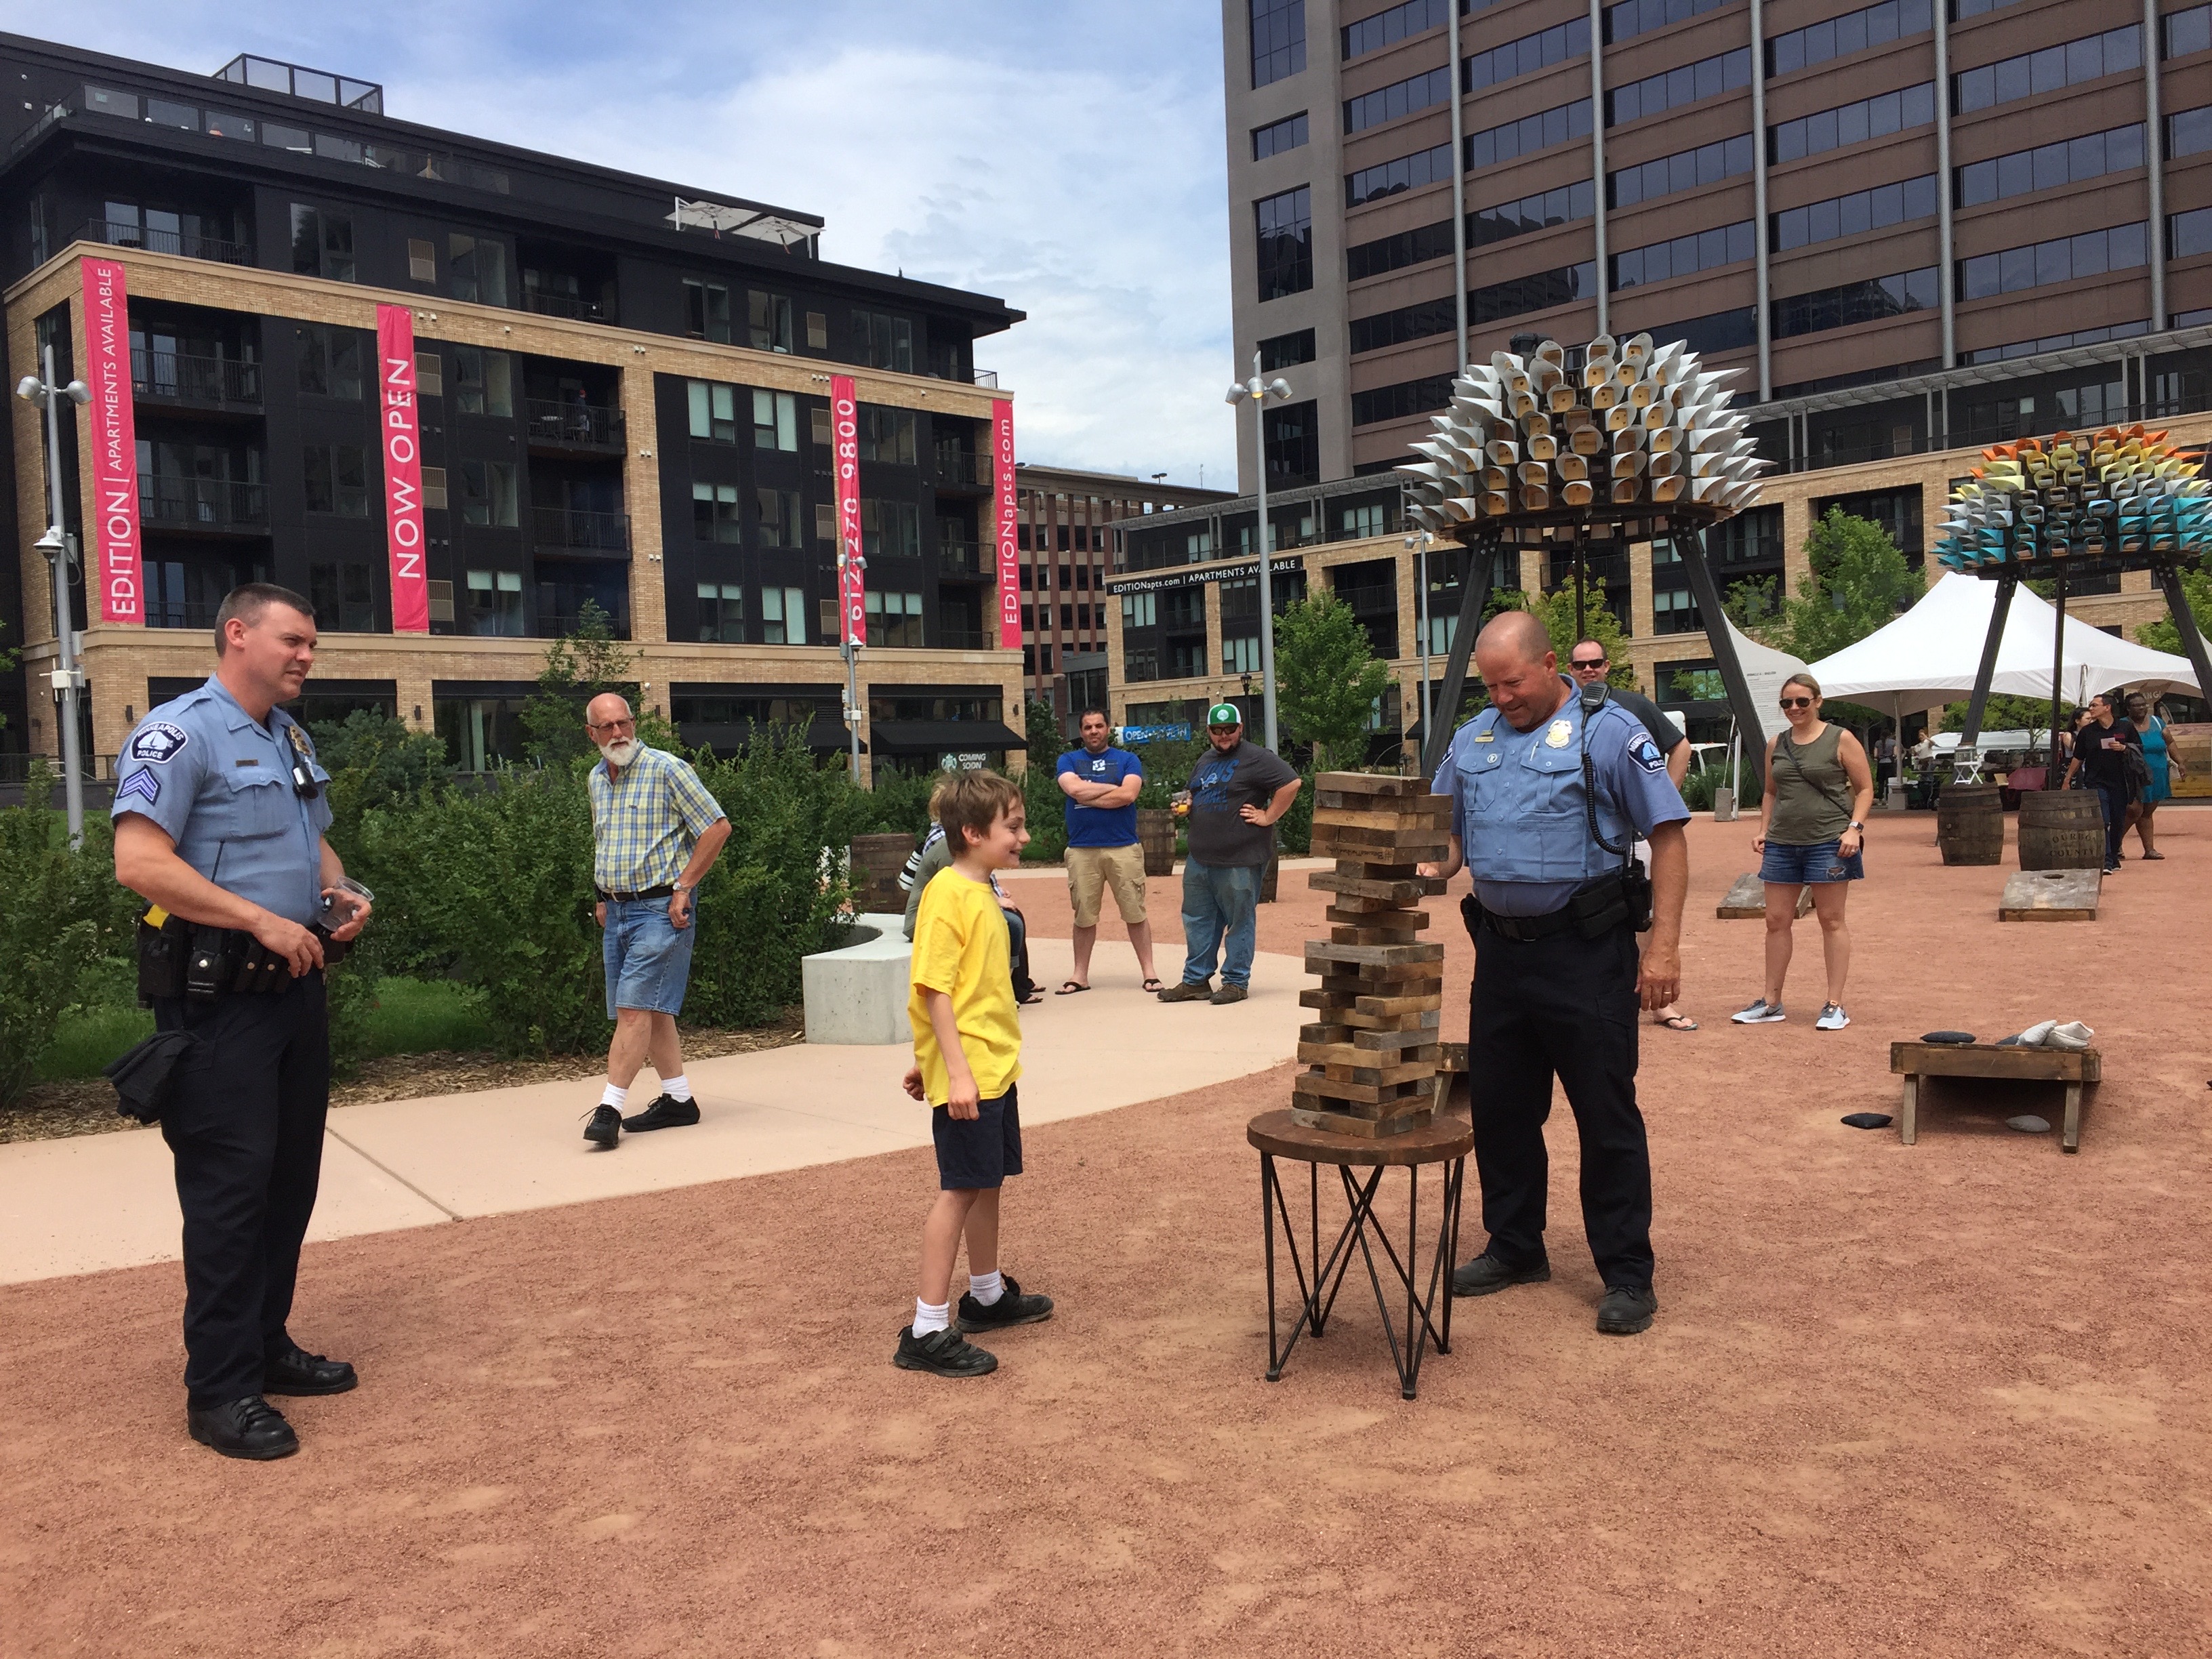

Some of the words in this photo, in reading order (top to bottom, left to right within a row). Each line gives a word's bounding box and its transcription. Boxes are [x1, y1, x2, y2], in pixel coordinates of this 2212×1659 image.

[98, 268, 116, 356] AVAILABLE
[103, 362, 123, 470] APARTMENTS
[386, 359, 414, 463] OPEN
[837, 399, 856, 479] 9800
[106, 492, 136, 614] EDITION
[392, 476, 421, 578] NOW
[1001, 419, 1017, 624] EDITIONapts.com
[1113, 578, 1180, 594] EDITIONapts.com
[1188, 567, 1244, 583] APARTMENTS
[137, 750, 163, 758] POLICE
[958, 753, 986, 762] COMING
[962, 762, 982, 770] SOON
